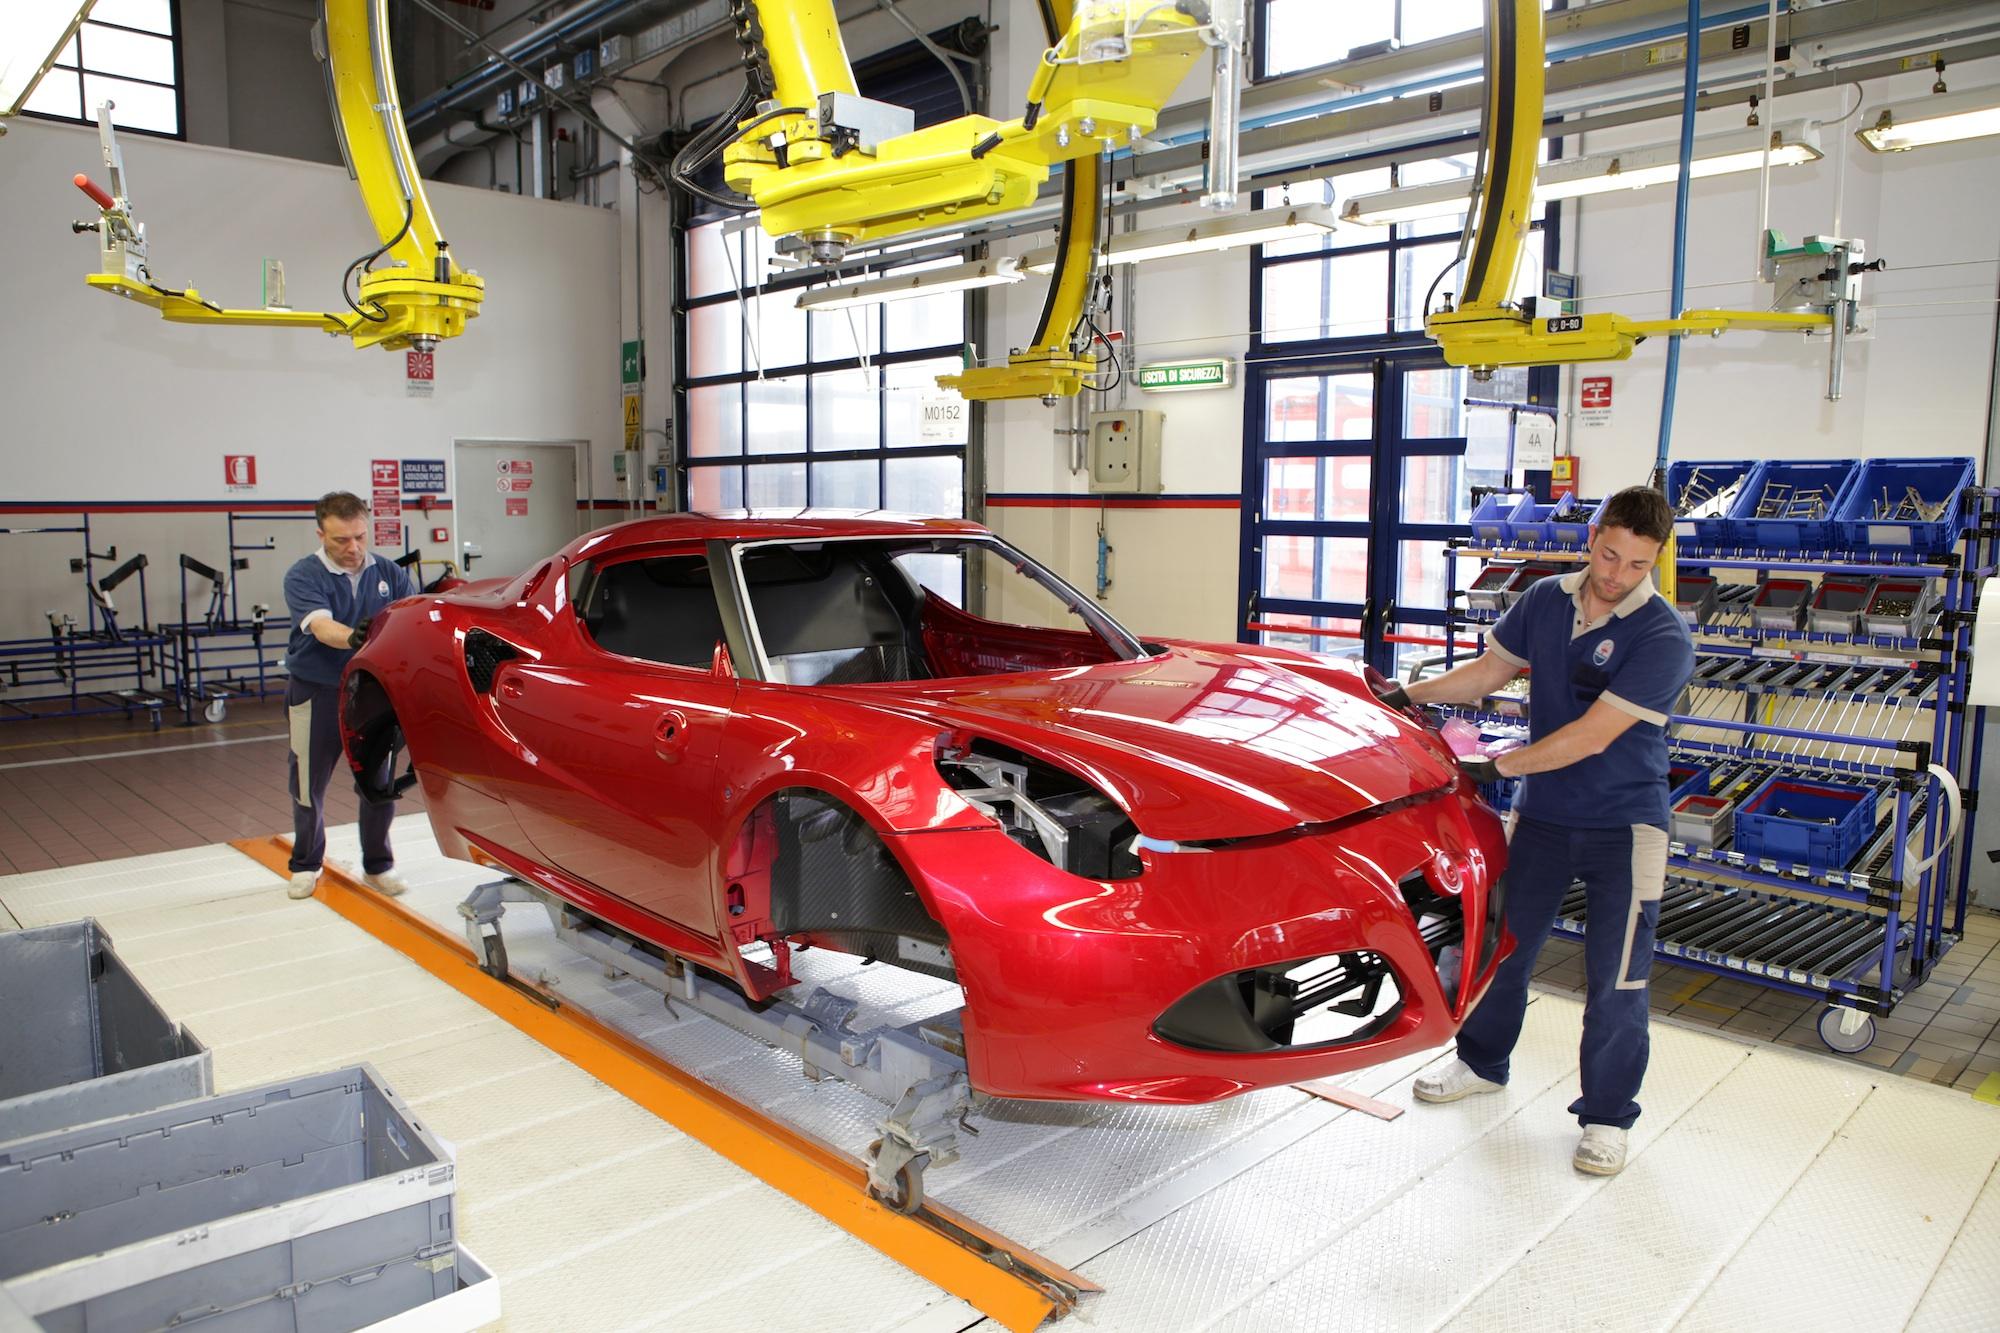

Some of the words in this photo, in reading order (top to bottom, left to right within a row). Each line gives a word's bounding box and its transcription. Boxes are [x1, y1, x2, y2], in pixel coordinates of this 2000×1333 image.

[1141, 370, 1167, 384] USCITA
[1169, 369, 1178, 382] DI
[1179, 366, 1221, 382] SICUREZZA
[925, 405, 960, 420] M0152
[1528, 431, 1542, 448] 4A
[404, 464, 420, 472] LOCALE
[429, 464, 444, 472] POMPE
